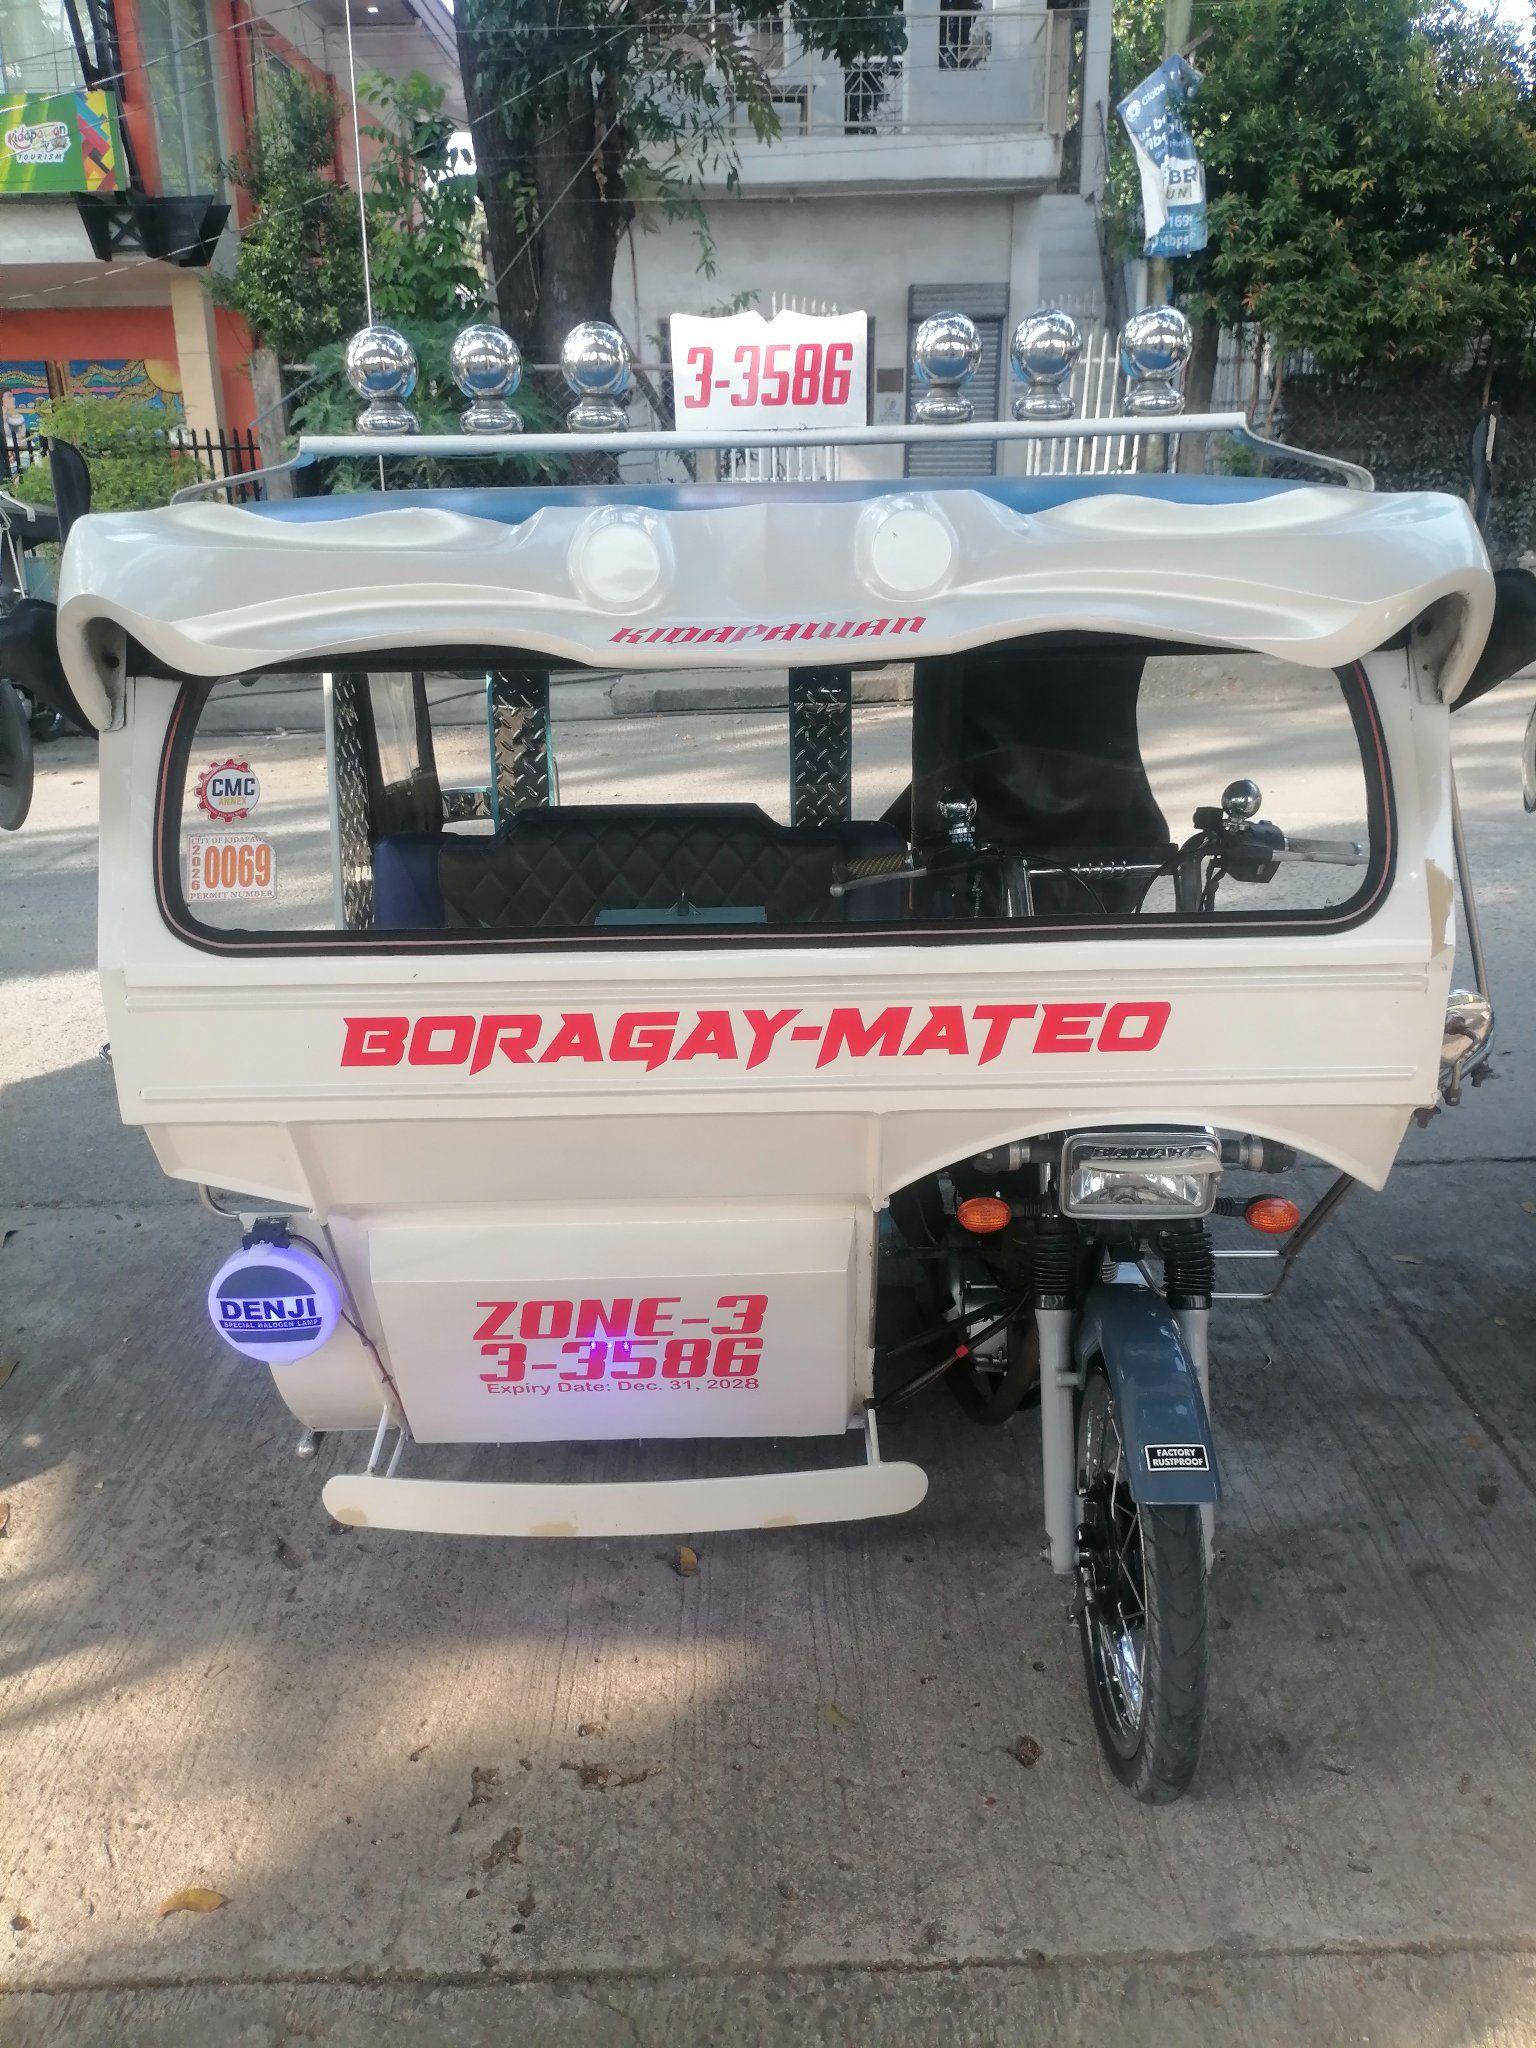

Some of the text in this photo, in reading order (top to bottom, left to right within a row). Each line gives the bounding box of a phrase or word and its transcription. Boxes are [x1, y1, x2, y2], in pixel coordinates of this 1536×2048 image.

[1141, 83, 1166, 105] Globe
[684, 343, 854, 409] 3-3586
[212, 778, 256, 796] CMC
[219, 797, 246, 805] ANNEX
[191, 837, 209, 845] CITY
[192, 845, 201, 891] 2026
[204, 844, 272, 889] 0069
[190, 890, 273, 900] PERMIT NUMBER
[341, 1001, 1172, 1075] BORAGAY-MATEO
[219, 1298, 316, 1319] DENJI
[472, 1294, 769, 1341] ZONE-3
[224, 1320, 255, 1328] SPECIAL
[258, 1320, 294, 1328] HALOGEN
[479, 1337, 764, 1382] 3-3586
[486, 1377, 760, 1396] Expiry Date: Dec. 31, 2028
[1152, 1458, 1203, 1467] RUSTPROOF
[1156, 1449, 1196, 1457] FACTORY
